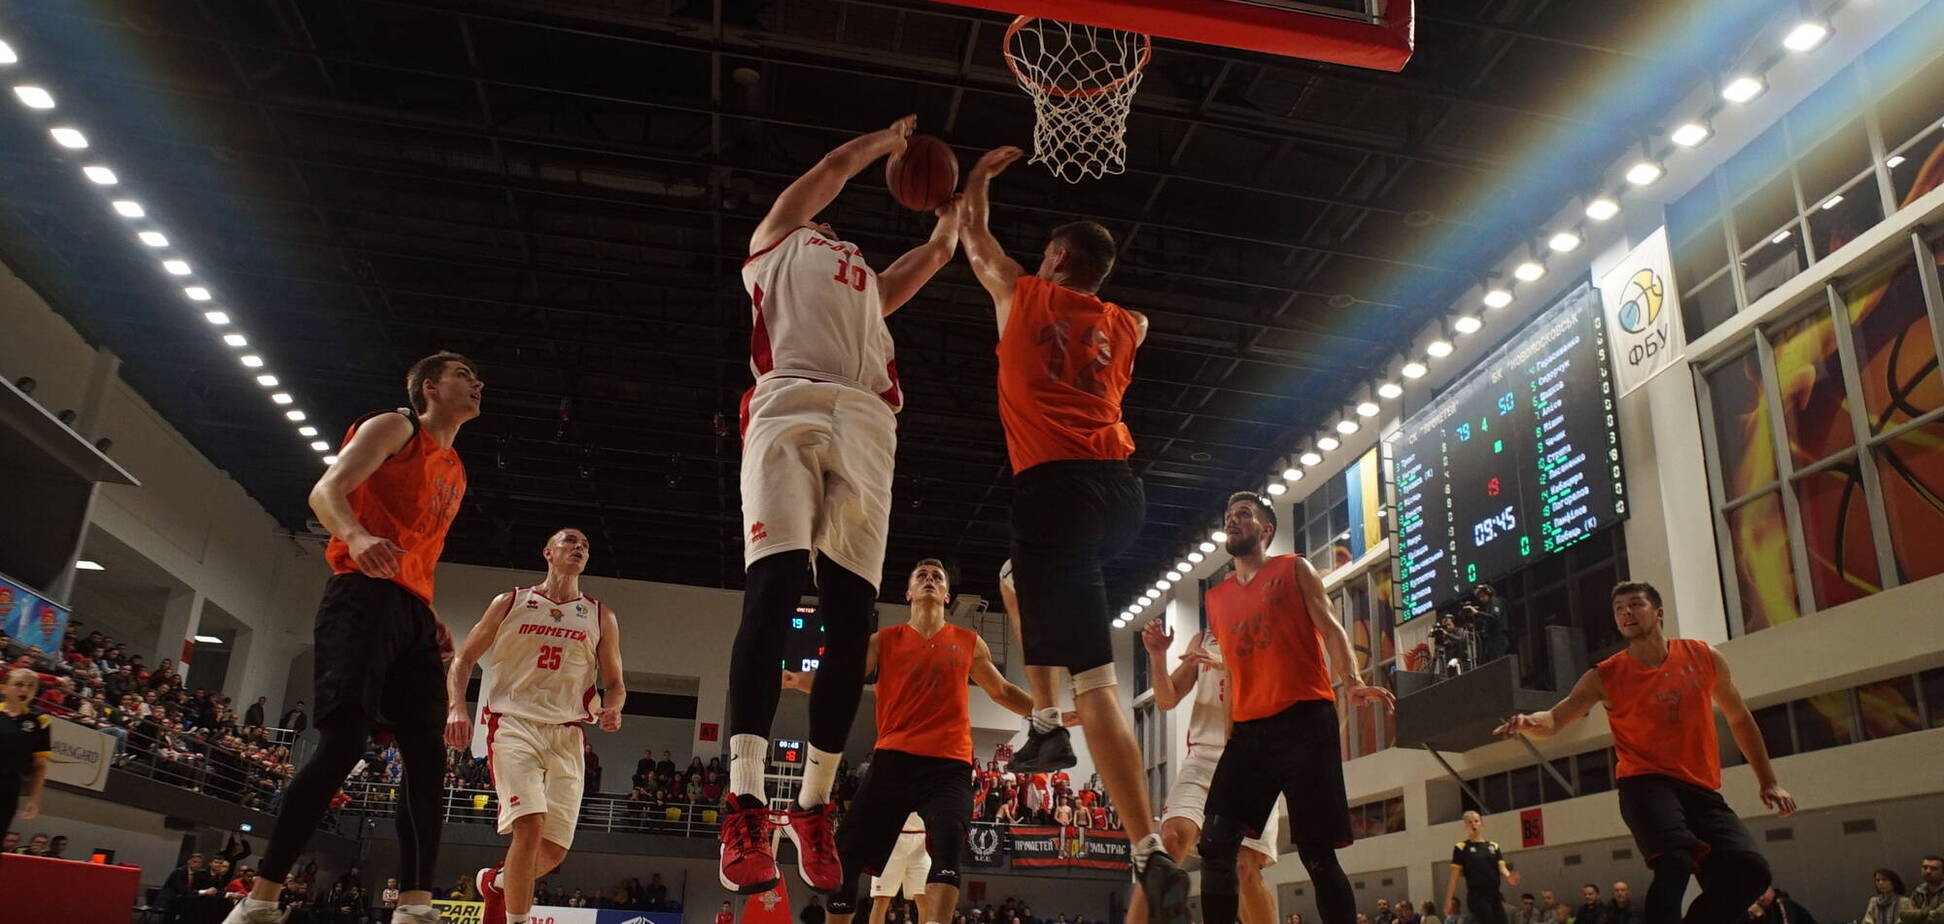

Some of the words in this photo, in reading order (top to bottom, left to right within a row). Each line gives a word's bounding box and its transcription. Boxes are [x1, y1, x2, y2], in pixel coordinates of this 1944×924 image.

[833, 259, 868, 292] 10
[1629, 323, 1668, 367] ФБУ
[1474, 505, 1518, 547] 09:45
[1520, 535, 1531, 557] 0
[1467, 563, 1478, 583] 0
[518, 623, 588, 642] ПРОМЕТЕЙ
[537, 645, 564, 671] 25
[440, 904, 482, 917] PARI
